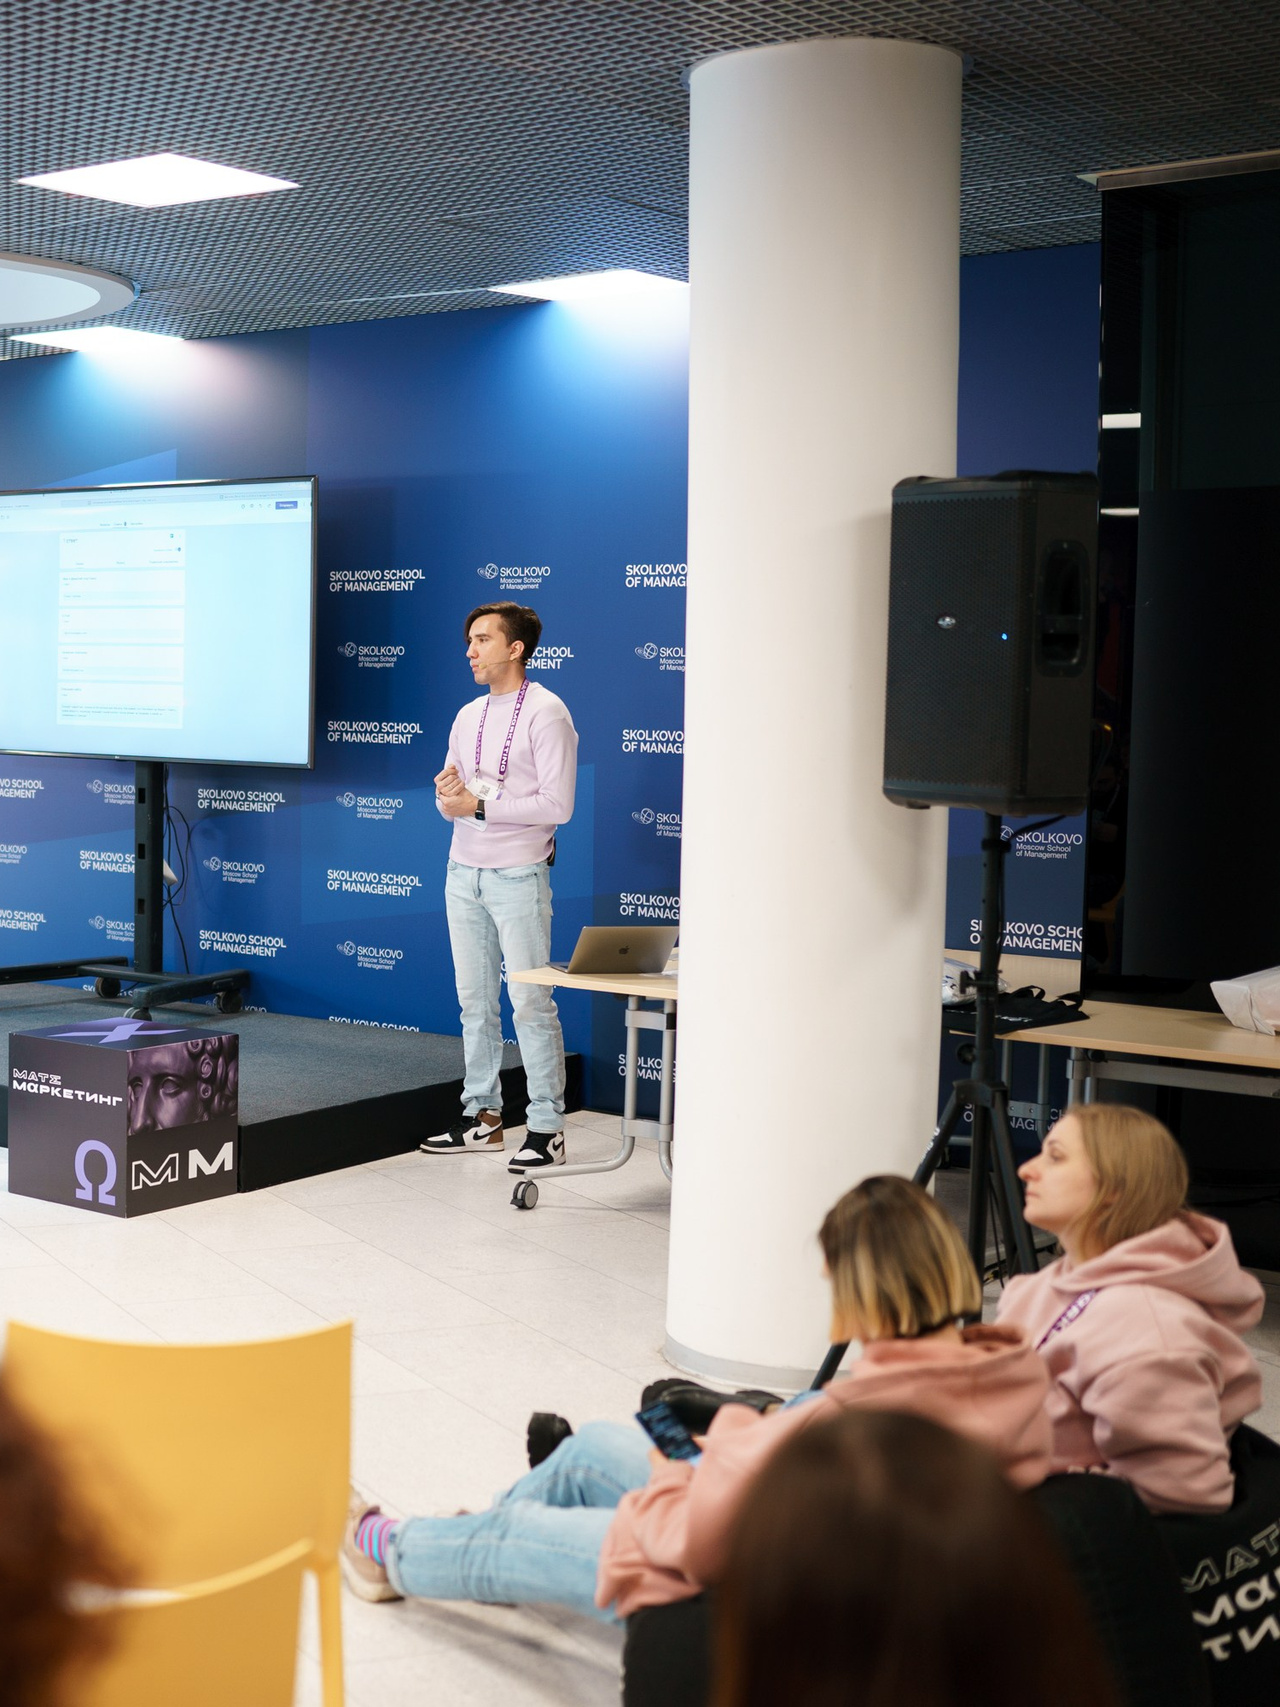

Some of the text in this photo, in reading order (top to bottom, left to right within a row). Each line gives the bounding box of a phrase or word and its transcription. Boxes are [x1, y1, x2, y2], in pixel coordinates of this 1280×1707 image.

[330, 569, 425, 581] SKOLKOVO SCHOOL
[500, 567, 550, 576] SKOLKOVO
[625, 564, 687, 575] SKOLKOVO
[330, 581, 414, 592] OF MANAGEMENT
[625, 577, 641, 587] OF
[358, 646, 405, 655] SKOLKOVO
[532, 647, 574, 657] CHOOL
[328, 721, 423, 733] SKOLKOVO SCHOOL
[328, 732, 412, 744] OF MANAGEMENT
[622, 730, 683, 741] SKOLKOVO
[622, 742, 638, 752] OF
[12, 779, 44, 789] SCHOOL
[198, 789, 285, 803] SKOLKOVO SCHOOL
[198, 800, 275, 812] OF MANAGEMENT
[357, 797, 403, 808] SKOLKOVO
[1016, 832, 1082, 845] SKOLKOVO
[80, 851, 123, 862] SKOLKOVO
[80, 861, 134, 873] OF MANAGEM
[222, 862, 264, 873] SKOLKOVO
[327, 870, 422, 886] SKOLKOVO SCHOOL
[327, 880, 411, 897] OF MANAGEMENT
[620, 893, 680, 907] SKOLKOVO
[620, 905, 635, 915] OF
[14, 911, 46, 922] SCHOOL
[200, 930, 286, 948] SKOLKOVO SCHOOL
[200, 941, 276, 957] OF MANAGEMENT
[357, 946, 403, 959] SKOLKOVO
